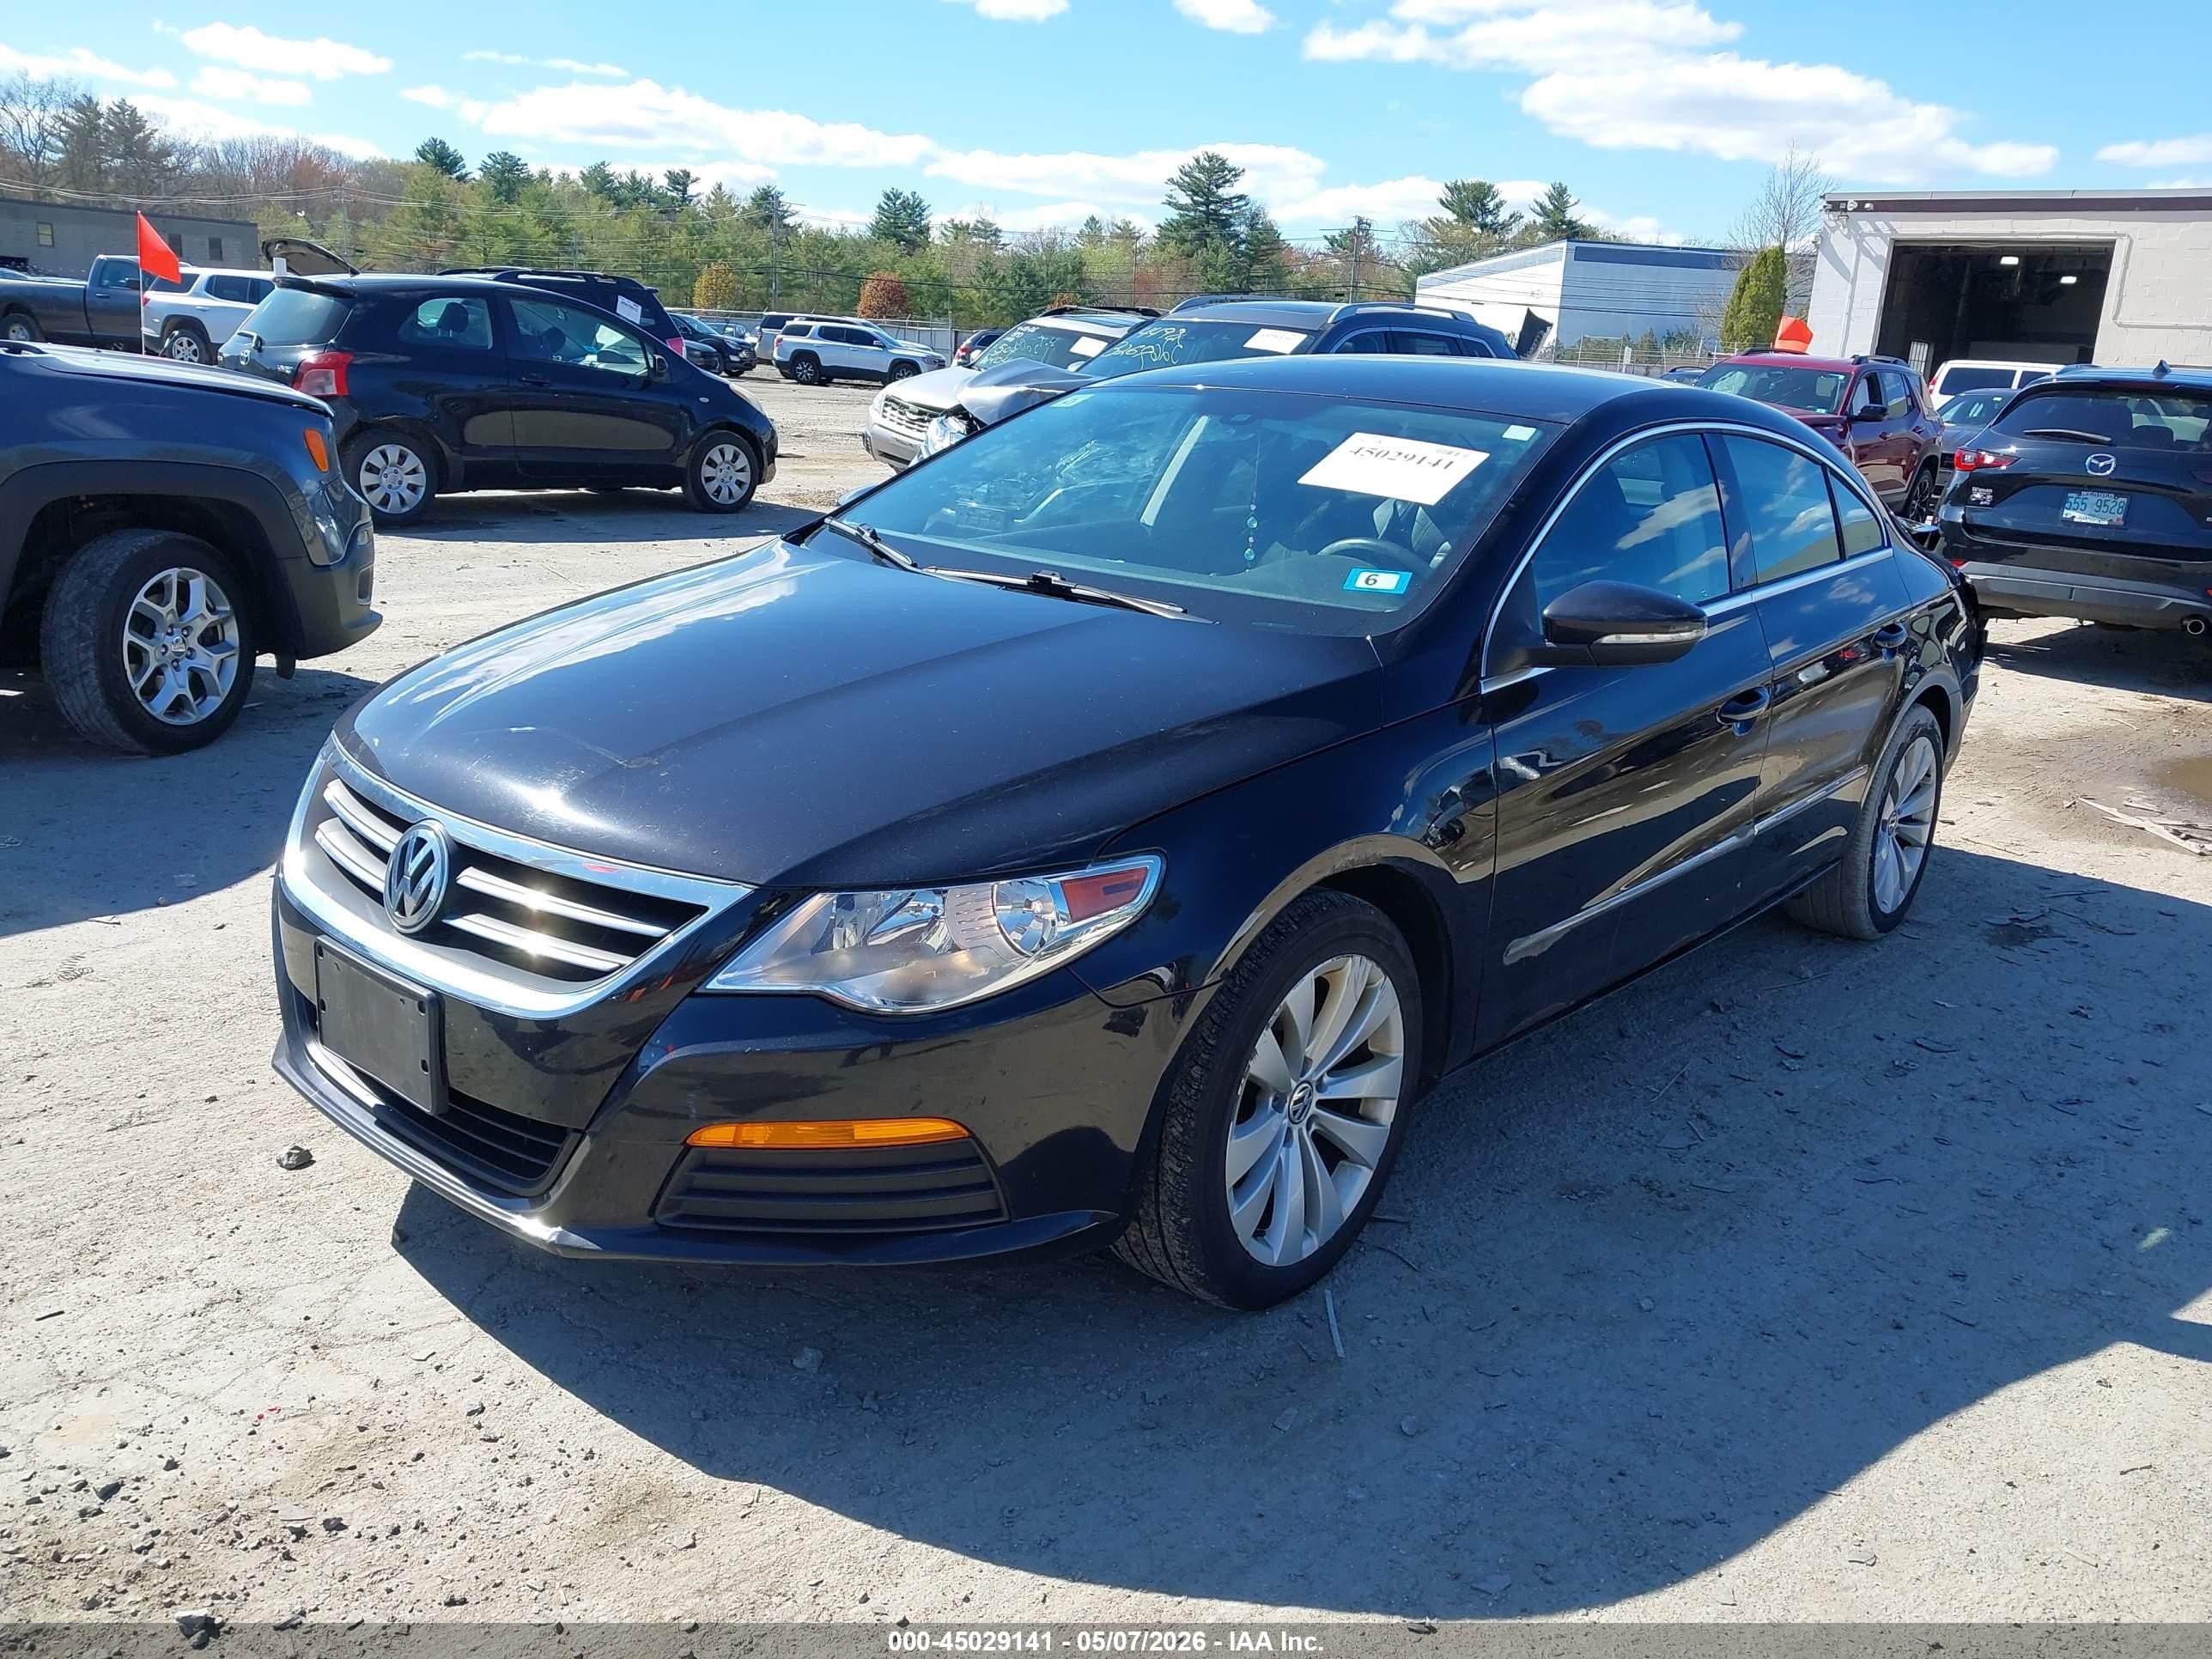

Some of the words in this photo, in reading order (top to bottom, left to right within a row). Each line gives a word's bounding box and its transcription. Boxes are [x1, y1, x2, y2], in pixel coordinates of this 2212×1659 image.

[1349, 446, 1454, 470] 45029141
[2064, 495, 2089, 512] 555
[2094, 498, 2125, 515] 9528
[1364, 574, 1379, 586] 6
